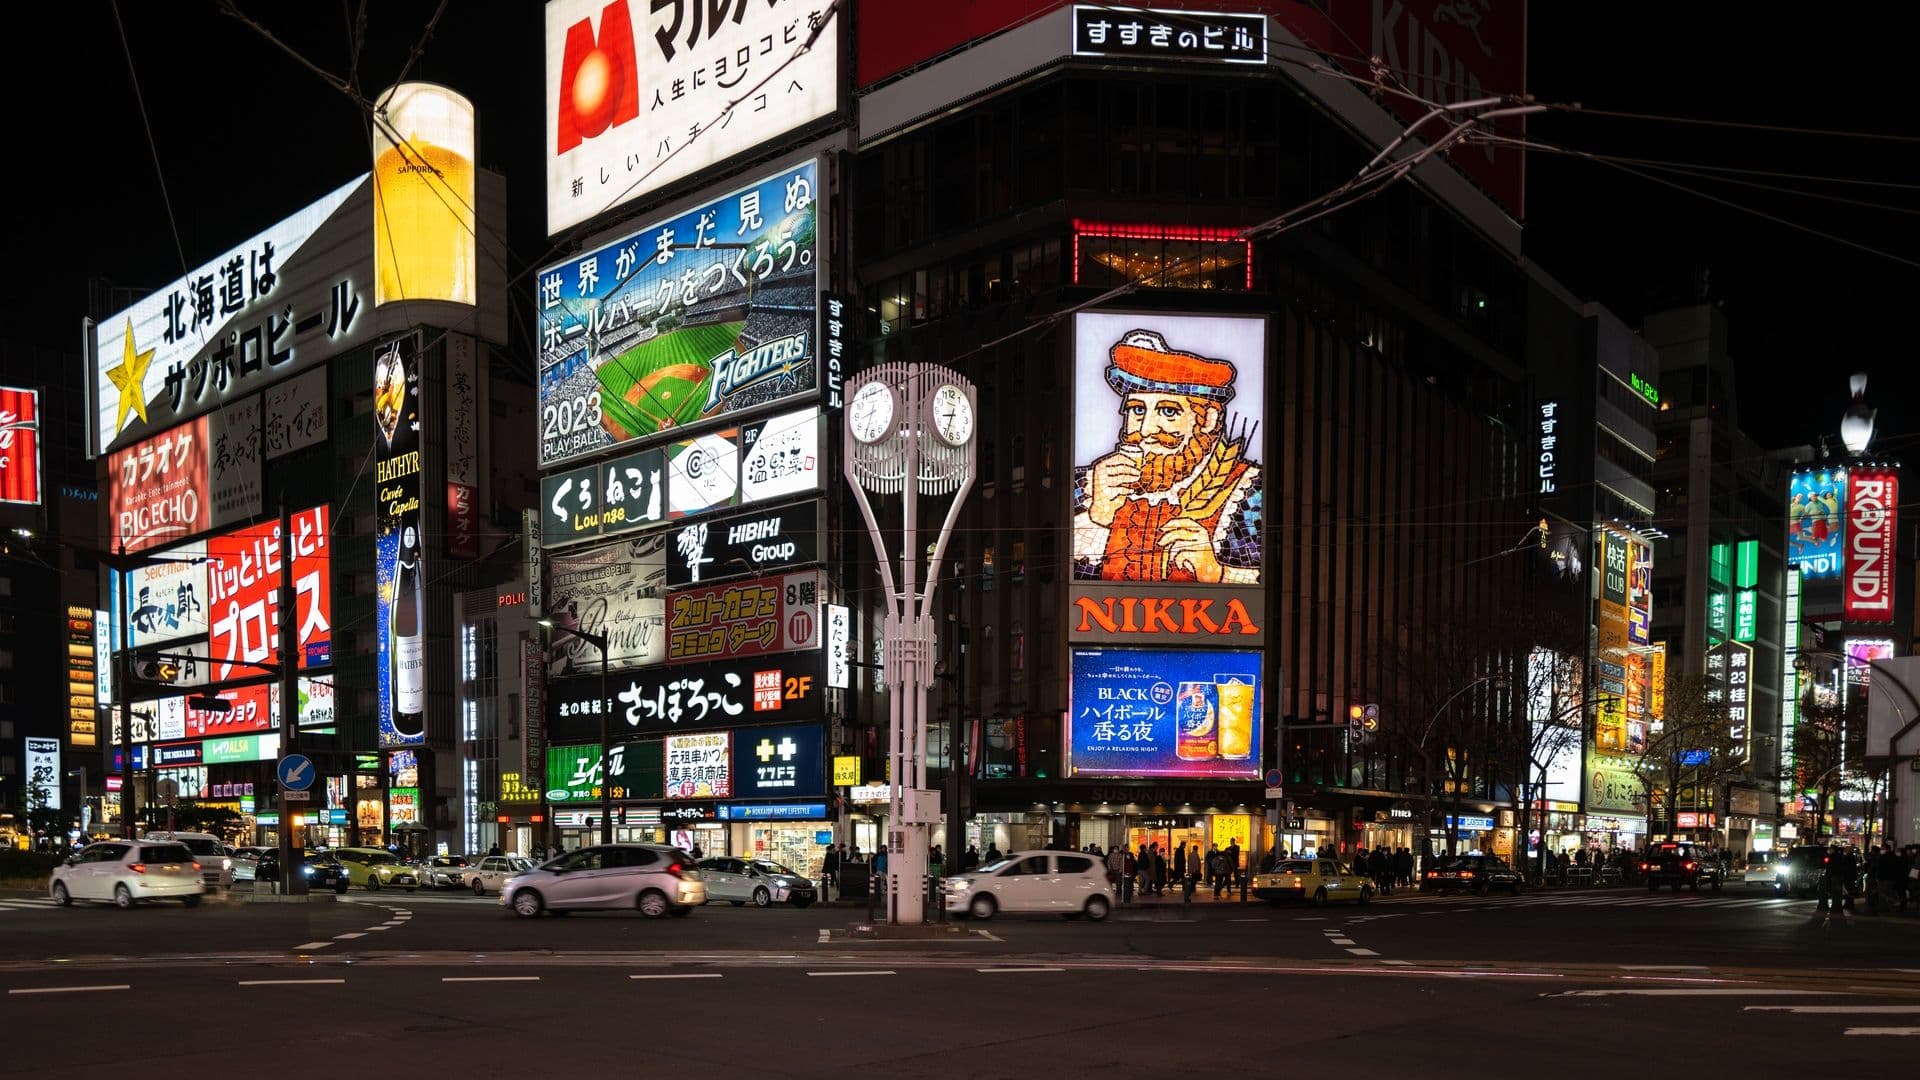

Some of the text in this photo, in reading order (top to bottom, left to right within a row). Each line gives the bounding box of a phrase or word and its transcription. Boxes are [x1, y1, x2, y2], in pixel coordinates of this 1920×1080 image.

[1086, 20, 1254, 50] すすきのビル
[398, 165, 433, 175] SAPPORO
[542, 174, 812, 311] 世界がまだ見ぬ
[162, 240, 279, 346] 北海道は
[543, 231, 812, 351] ボールパークをつくろう。
[163, 280, 361, 413] サッポロビール
[828, 299, 843, 409] すすきのビル
[702, 331, 808, 413] FIGHTERS
[543, 391, 602, 440] 2023
[544, 432, 602, 456] PLAY BALL
[745, 429, 758, 443] 2F
[1540, 402, 1557, 493] すすきのビル
[122, 433, 193, 488] カラオケ
[377, 450, 420, 484] HATHYR
[380, 484, 403, 503] Cuvée
[389, 496, 419, 517] Capella
[551, 466, 643, 523] くろねこ
[119, 506, 149, 545] BIG
[151, 489, 198, 524] ECHO
[456, 486, 470, 546] カラオケ
[574, 507, 625, 531] Lounge
[728, 517, 781, 545] HIBIKI
[752, 542, 795, 562] Group
[1607, 543, 1625, 572] 快活
[1852, 480, 1889, 610] ROUND1
[1607, 572, 1624, 594] CLUB
[131, 580, 201, 634] 長次郎
[671, 588, 777, 627] ネットカフェ
[1073, 596, 1261, 635] NIKKA
[567, 598, 651, 658] Pmier
[671, 622, 776, 657] コミック ダーツ
[618, 673, 743, 726] さっぽろっこ
[785, 676, 812, 700] 2F
[1098, 687, 1148, 700] BLACK
[1080, 704, 1166, 721] ハイボール
[1091, 720, 1155, 742] 香る夜
[568, 746, 625, 787] エイル
[670, 748, 721, 765] 元祖串かつ
[757, 766, 796, 780] サツドラ
[774, 805, 788, 816] HAPPY
